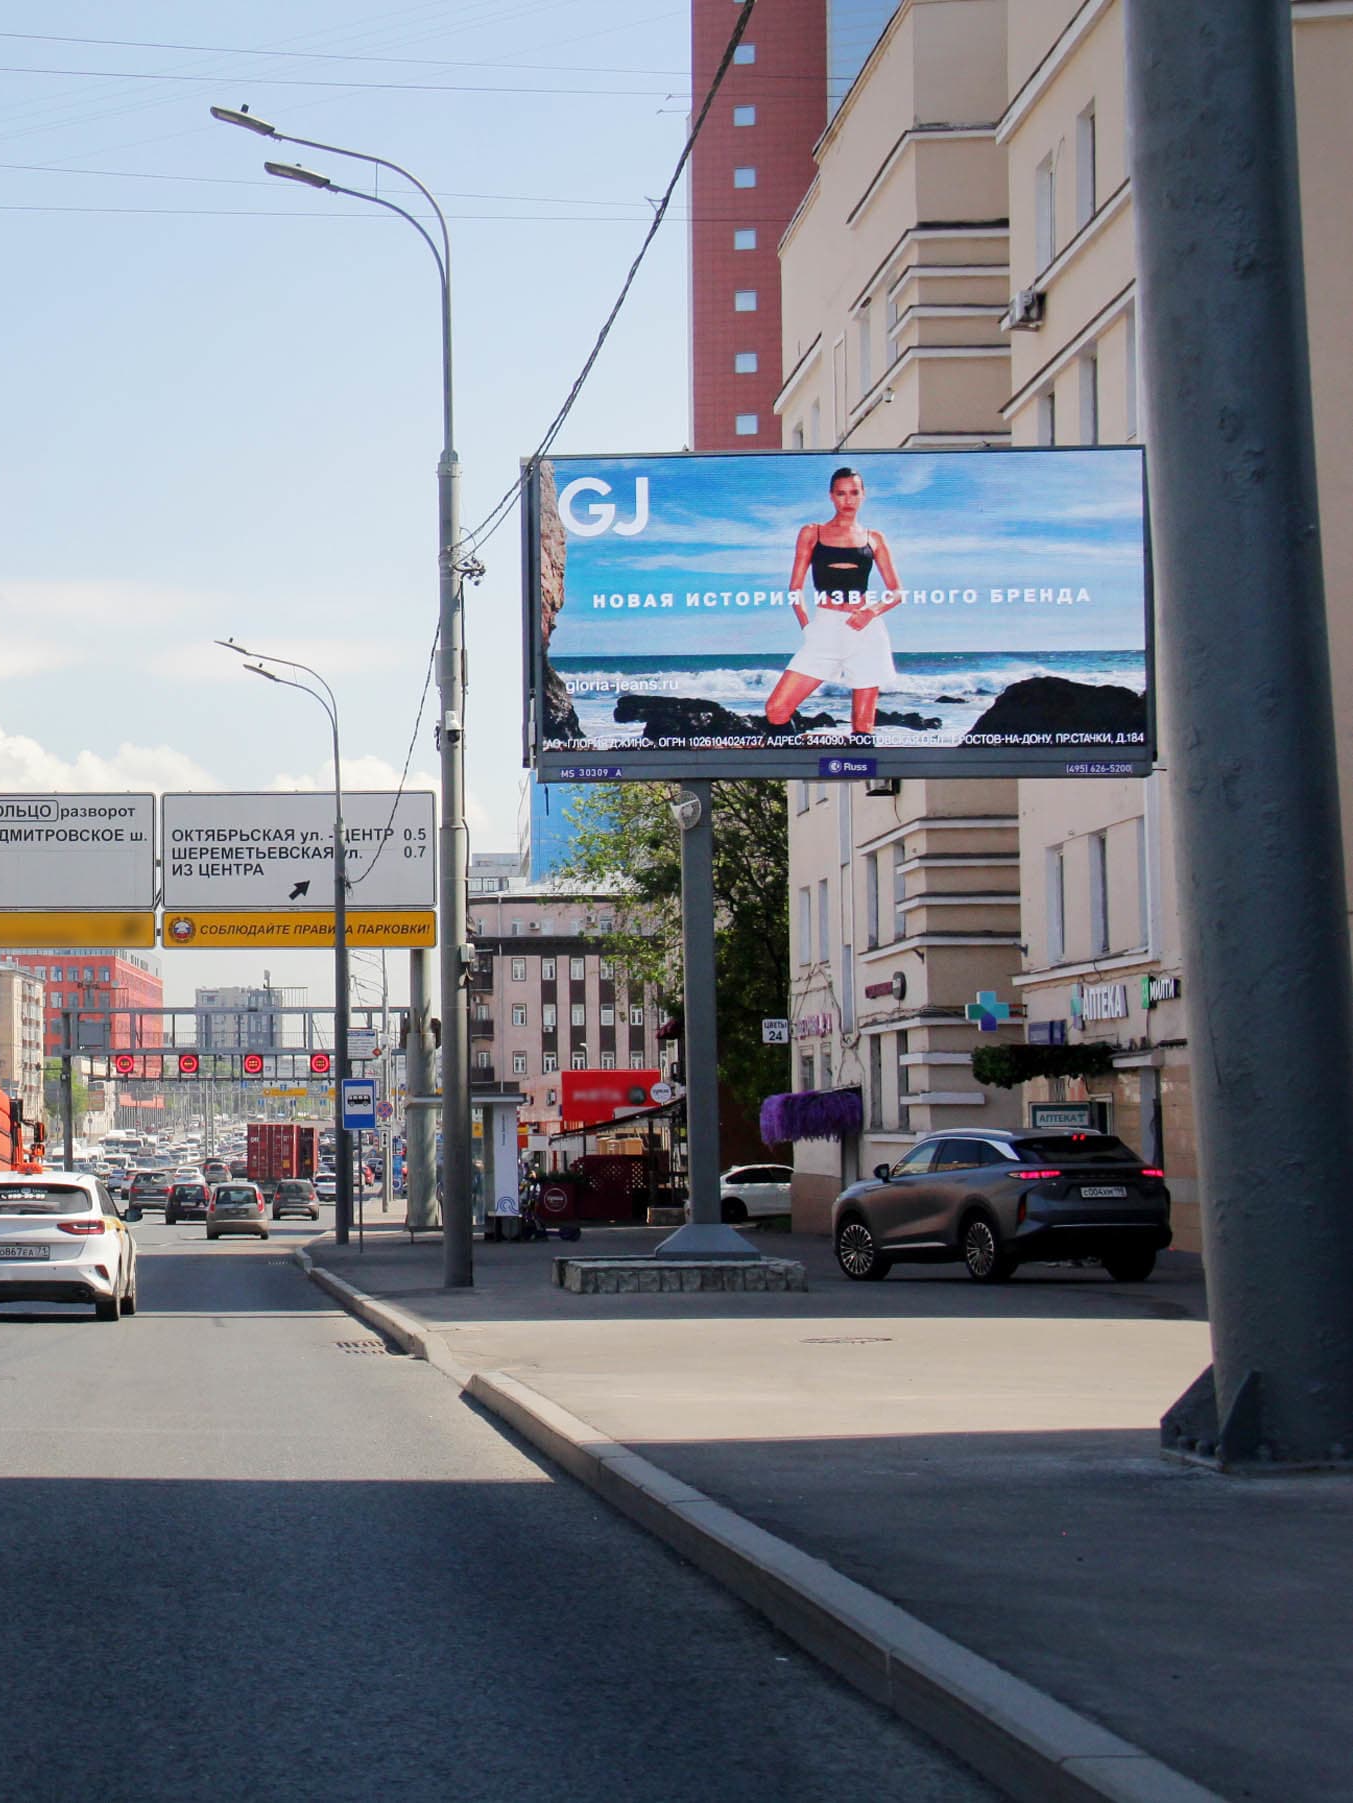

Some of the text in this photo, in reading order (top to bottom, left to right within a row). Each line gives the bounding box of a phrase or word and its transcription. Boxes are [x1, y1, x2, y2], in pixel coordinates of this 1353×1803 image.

[558, 476, 649, 537] GJ
[593, 588, 1091, 608] НОВАЯ ИСТОРИЯ ИЗВЕСТНОГО БРЕНДА
[565, 678, 679, 695] gloria-jeans.ru
[658, 737, 685, 747] ОГРН
[767, 736, 804, 746] АДРЕС:
[1115, 732, 1144, 744] Д.184
[560, 769, 575, 778] MS
[843, 762, 868, 771] Russ
[60, 806, 136, 820] разворот
[130, 832, 148, 842] ш.
[172, 828, 295, 842] ОКТЯБРЬСКАЯ
[300, 832, 325, 845] ул.
[404, 828, 426, 841] 0.5
[172, 846, 334, 860] ШЕРЕМЕТЬЕВСКАЯ
[404, 846, 426, 859] 0.7
[172, 863, 264, 878] ИЗ ЦЕНТРА
[200, 922, 430, 936] СОБЛЮДАЙТЕ ПРАВИА ПАРКОВКИ!
[1082, 984, 1124, 1020] АПТЕКА
[769, 1031, 782, 1041] 24
[1039, 1114, 1076, 1122] АПТЕКА
